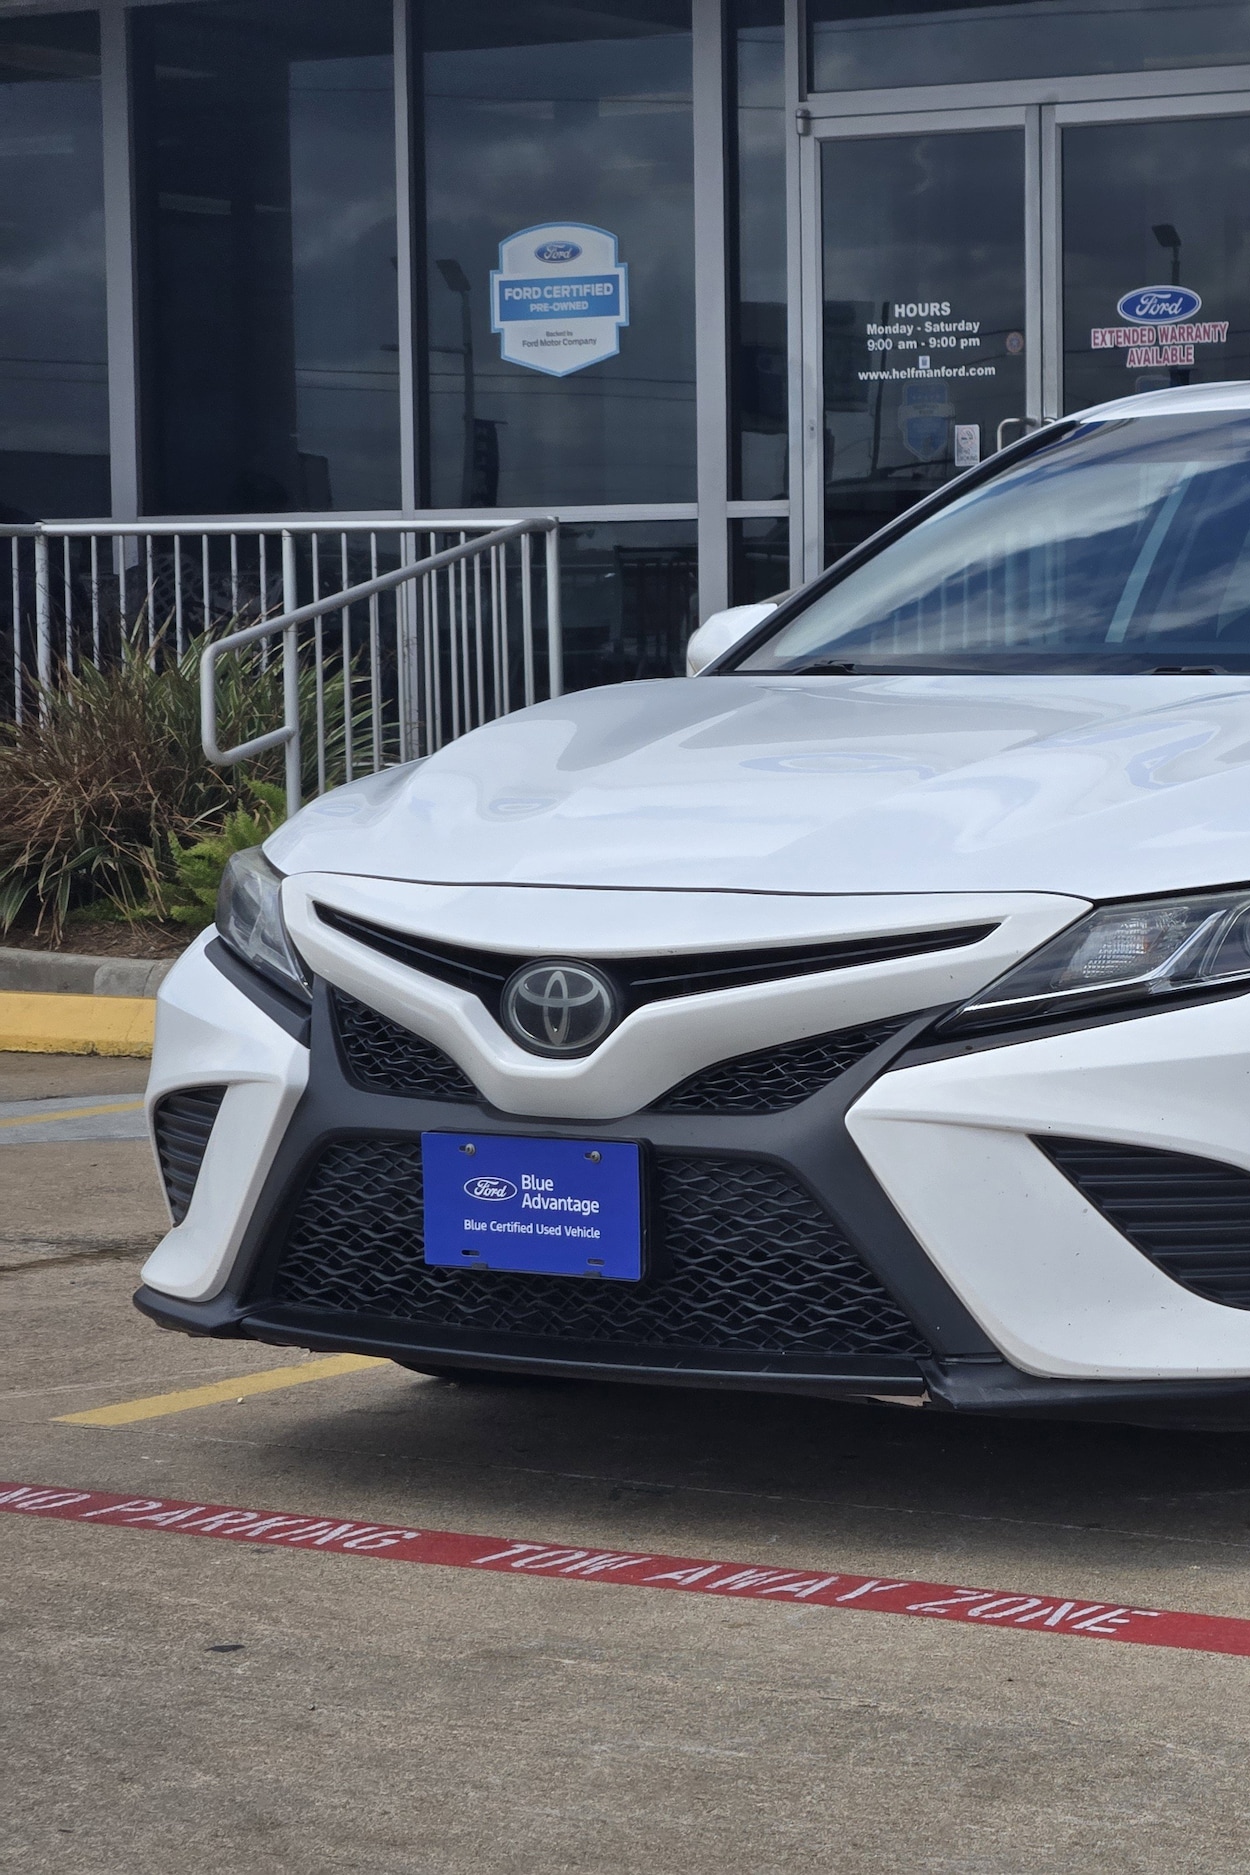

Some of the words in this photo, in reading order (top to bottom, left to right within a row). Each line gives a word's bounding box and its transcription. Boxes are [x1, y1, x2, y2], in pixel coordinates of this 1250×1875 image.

[504, 286, 542, 301] FORD
[543, 283, 614, 299] CERTIFIED
[530, 301, 589, 313] PRE-OWNED
[894, 302, 951, 318] HOURS
[867, 323, 914, 337] Monday
[924, 320, 980, 335] Saturday
[1091, 326, 1156, 349] EXTENDED
[1158, 321, 1229, 345] WARRANTY
[522, 339, 539, 348] Ford
[540, 338, 561, 347] Motor
[562, 338, 598, 346] Company
[867, 338, 893, 352] 9:00
[897, 340, 918, 350] am
[928, 336, 957, 349] 9:00
[960, 337, 980, 350] pm
[1126, 345, 1194, 368] AVAILABLE
[858, 365, 996, 380] www.helfmanford.com
[521, 1174, 554, 1192] Blue
[521, 1193, 600, 1216] Advantage
[464, 1219, 487, 1231] Blue
[489, 1220, 534, 1234] Certified
[536, 1224, 562, 1236] Used
[564, 1225, 600, 1239] Vehicle
[0, 1486, 92, 1511] NO
[79, 1499, 419, 1550] PARKING
[470, 1543, 652, 1576] TOW
[640, 1564, 905, 1602] AWAY
[905, 1589, 1162, 1634] ZONE
